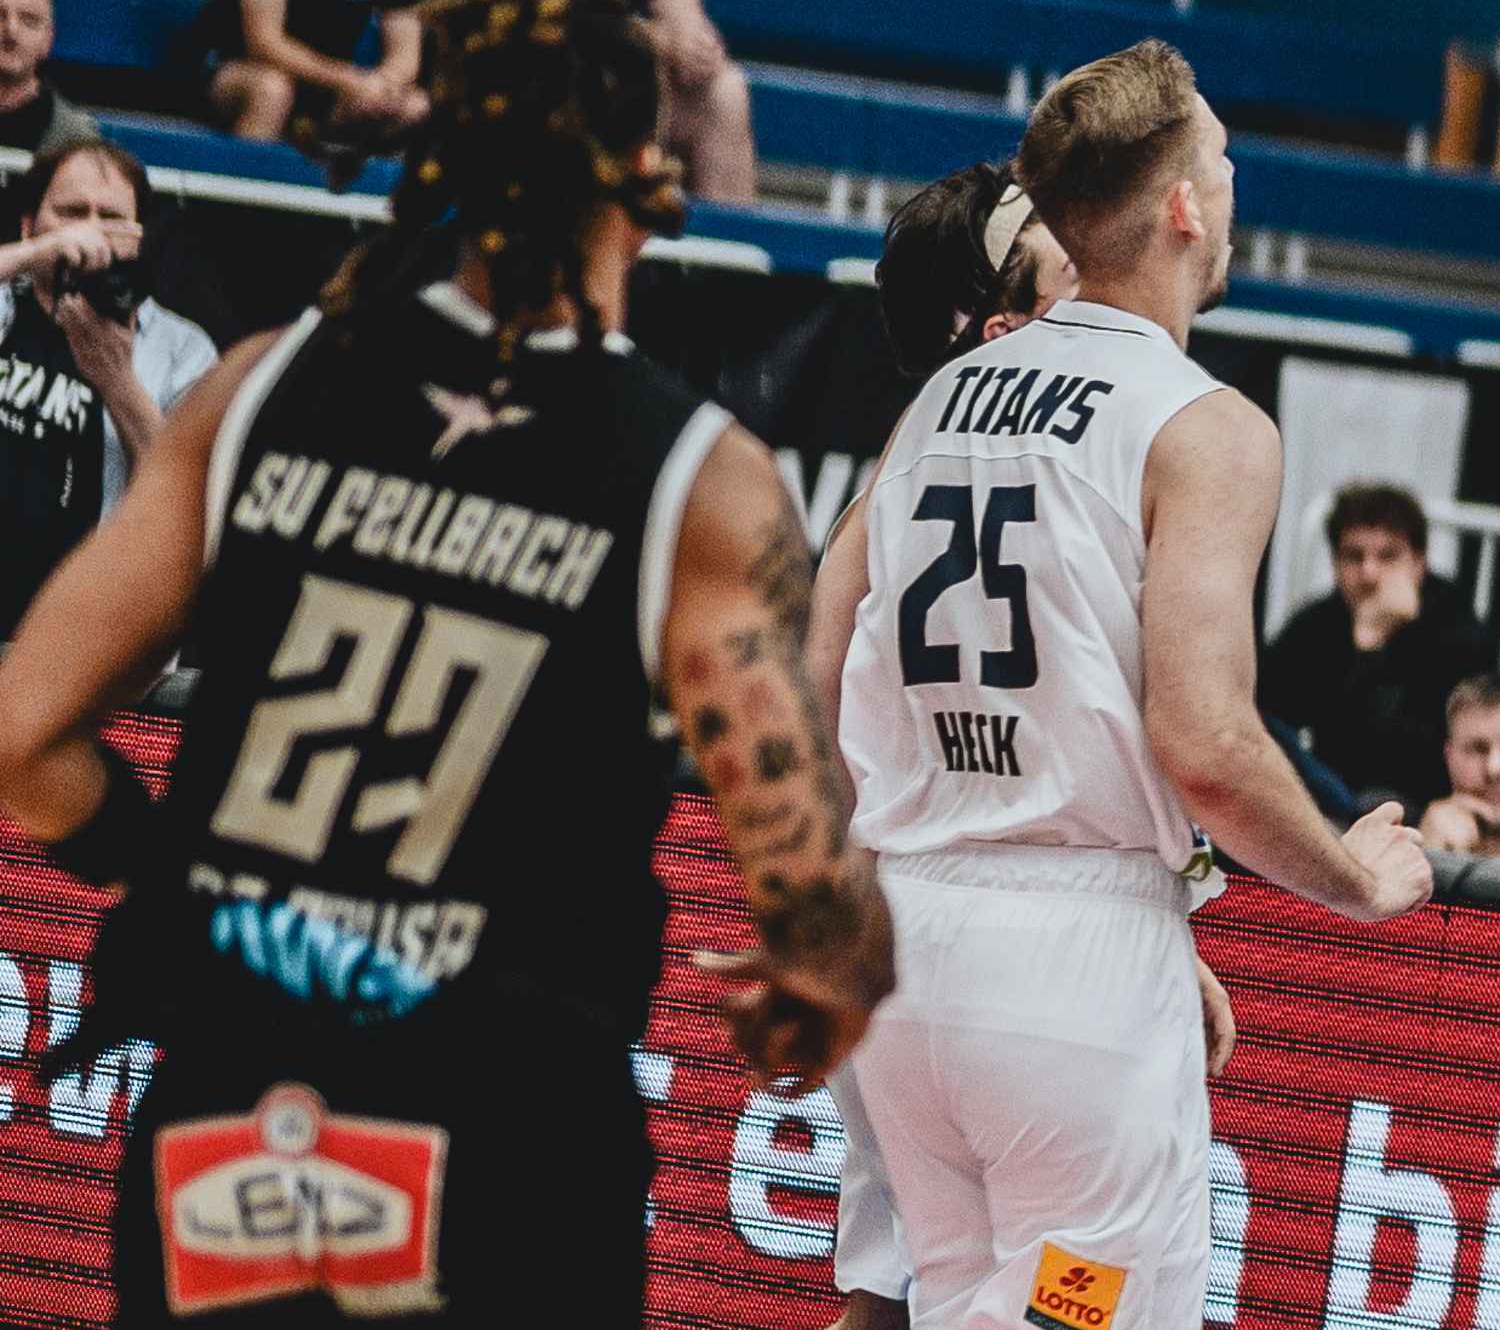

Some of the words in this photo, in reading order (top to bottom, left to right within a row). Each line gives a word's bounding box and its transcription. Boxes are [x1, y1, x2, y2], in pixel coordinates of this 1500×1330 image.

[935, 365, 1115, 444] TITANS
[898, 483, 1040, 690] 25
[209, 571, 551, 886] 27
[932, 711, 1022, 777] HECK
[1036, 1285, 1105, 1326] LOTTO
